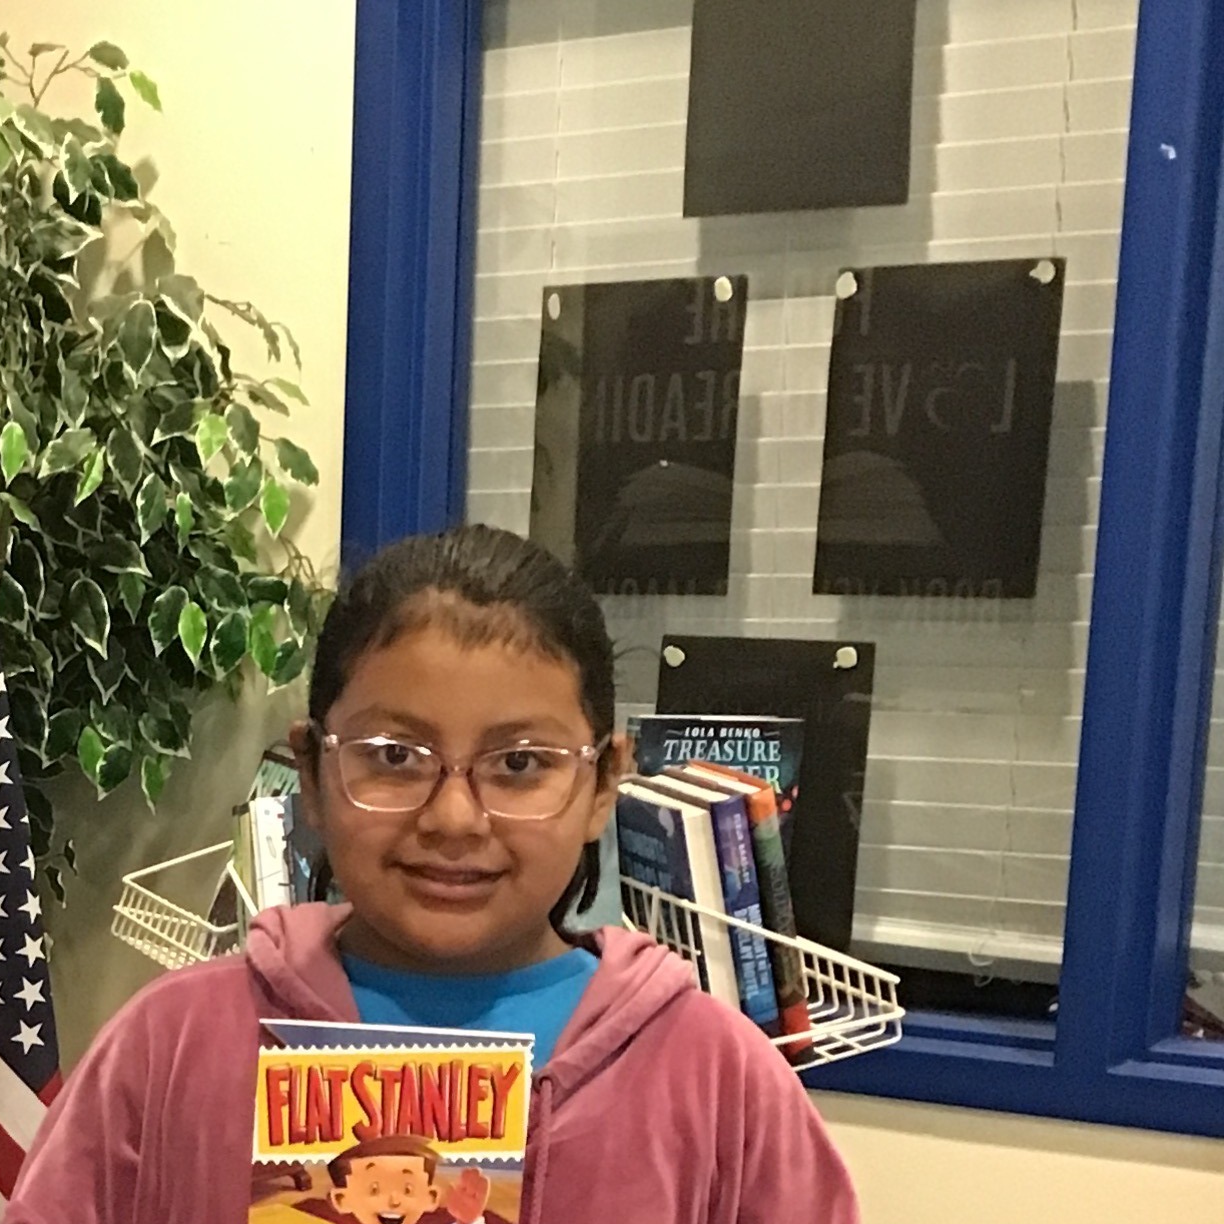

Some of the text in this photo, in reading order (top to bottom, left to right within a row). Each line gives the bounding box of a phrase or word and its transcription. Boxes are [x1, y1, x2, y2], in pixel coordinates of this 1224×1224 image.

[684, 726, 762, 739] LOLA BENKO
[662, 738, 782, 763] TREASURE
[265, 1058, 523, 1147] FLAT STANLEY
